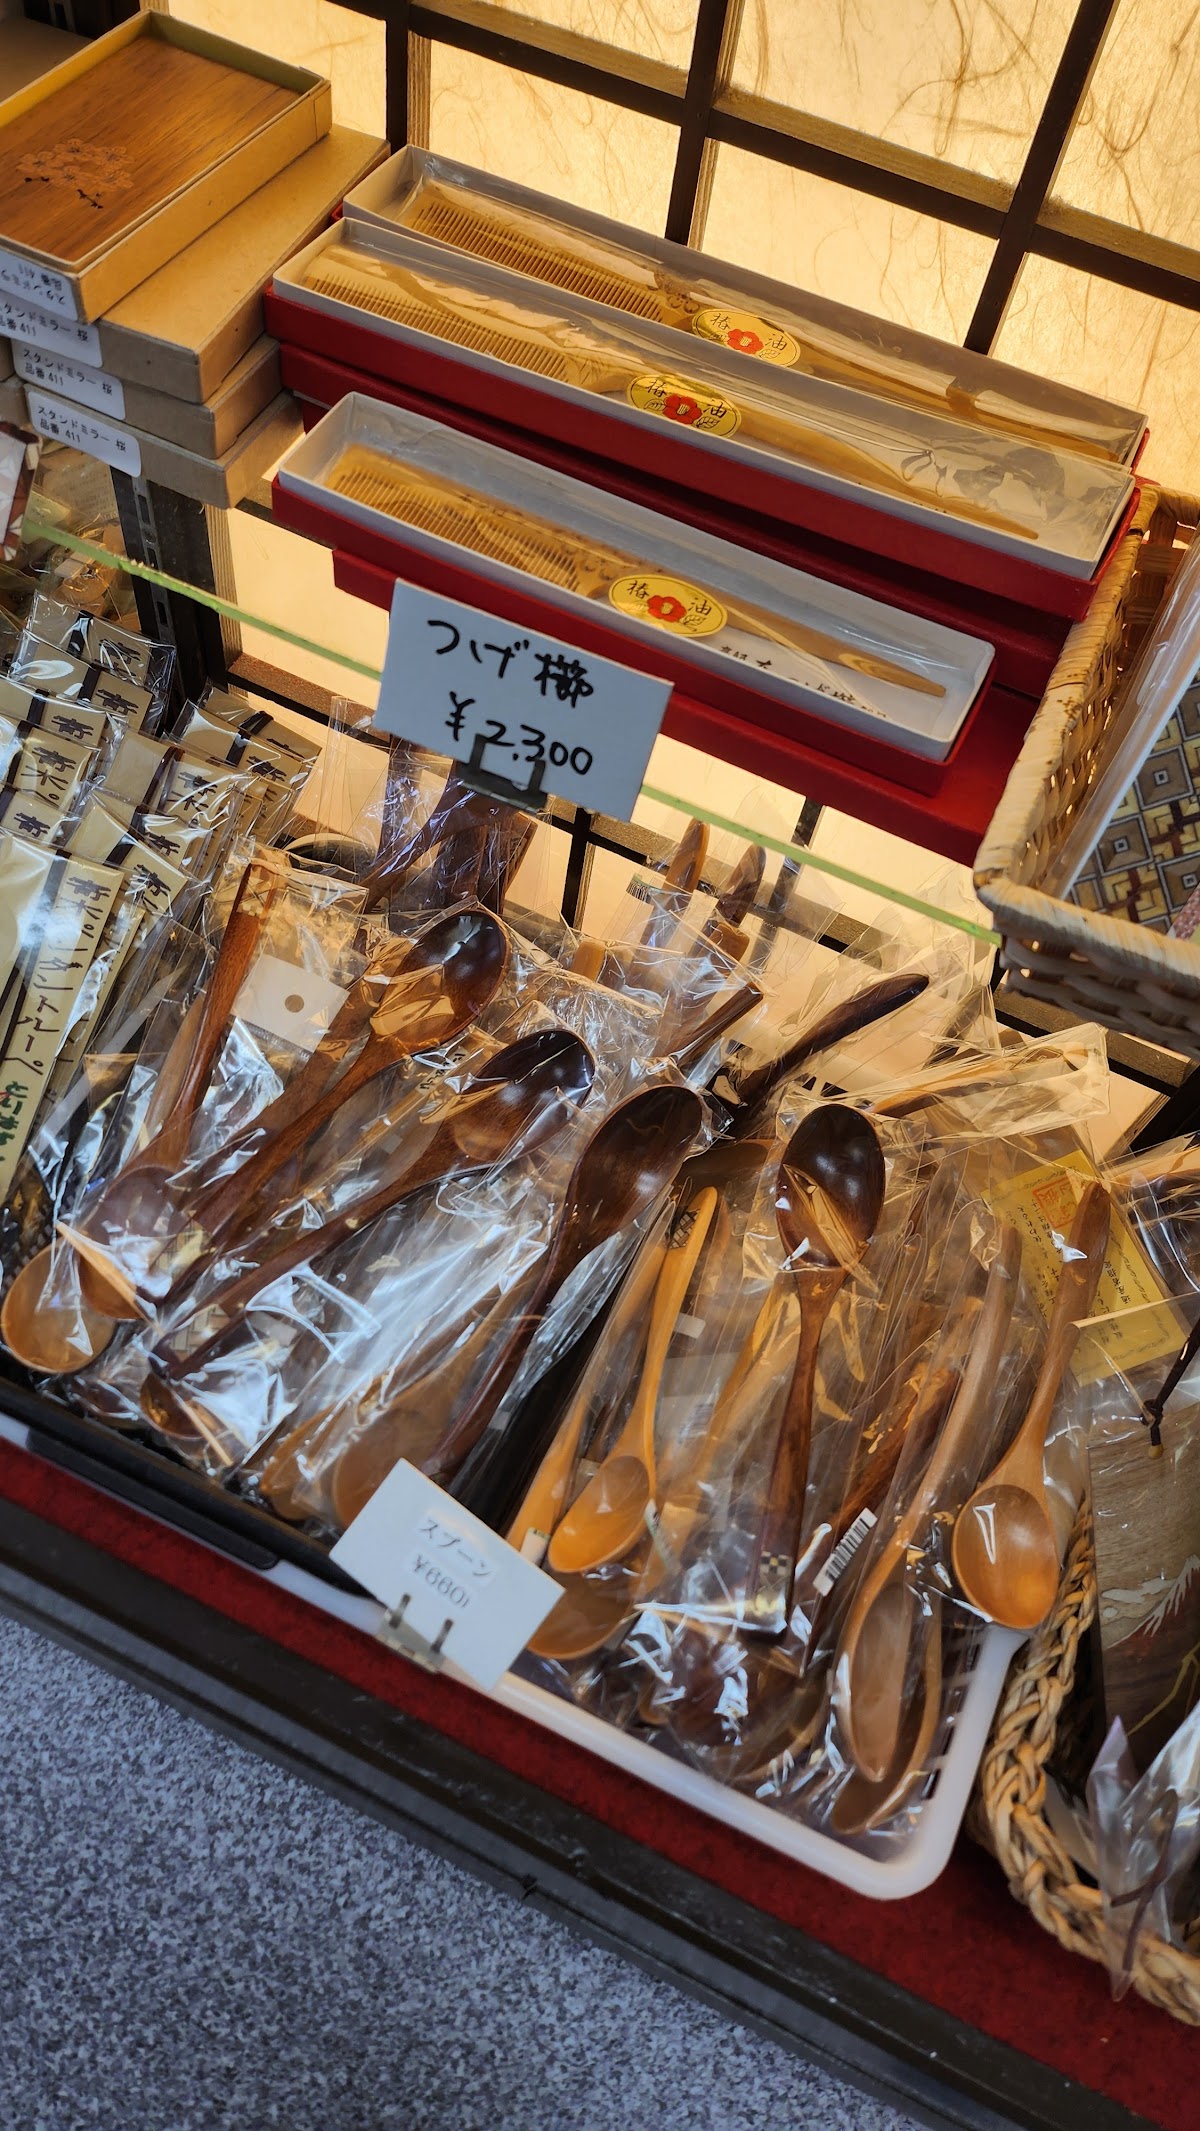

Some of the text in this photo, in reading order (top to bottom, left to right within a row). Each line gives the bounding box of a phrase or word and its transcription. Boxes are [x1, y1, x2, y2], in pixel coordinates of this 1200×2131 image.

[710, 312, 787, 351] 椿 油
[23, 348, 96, 385] スタンドミラー
[645, 378, 727, 419] 椿 油
[38, 405, 110, 442] スタンドミラー
[627, 580, 712, 616] 椿 油
